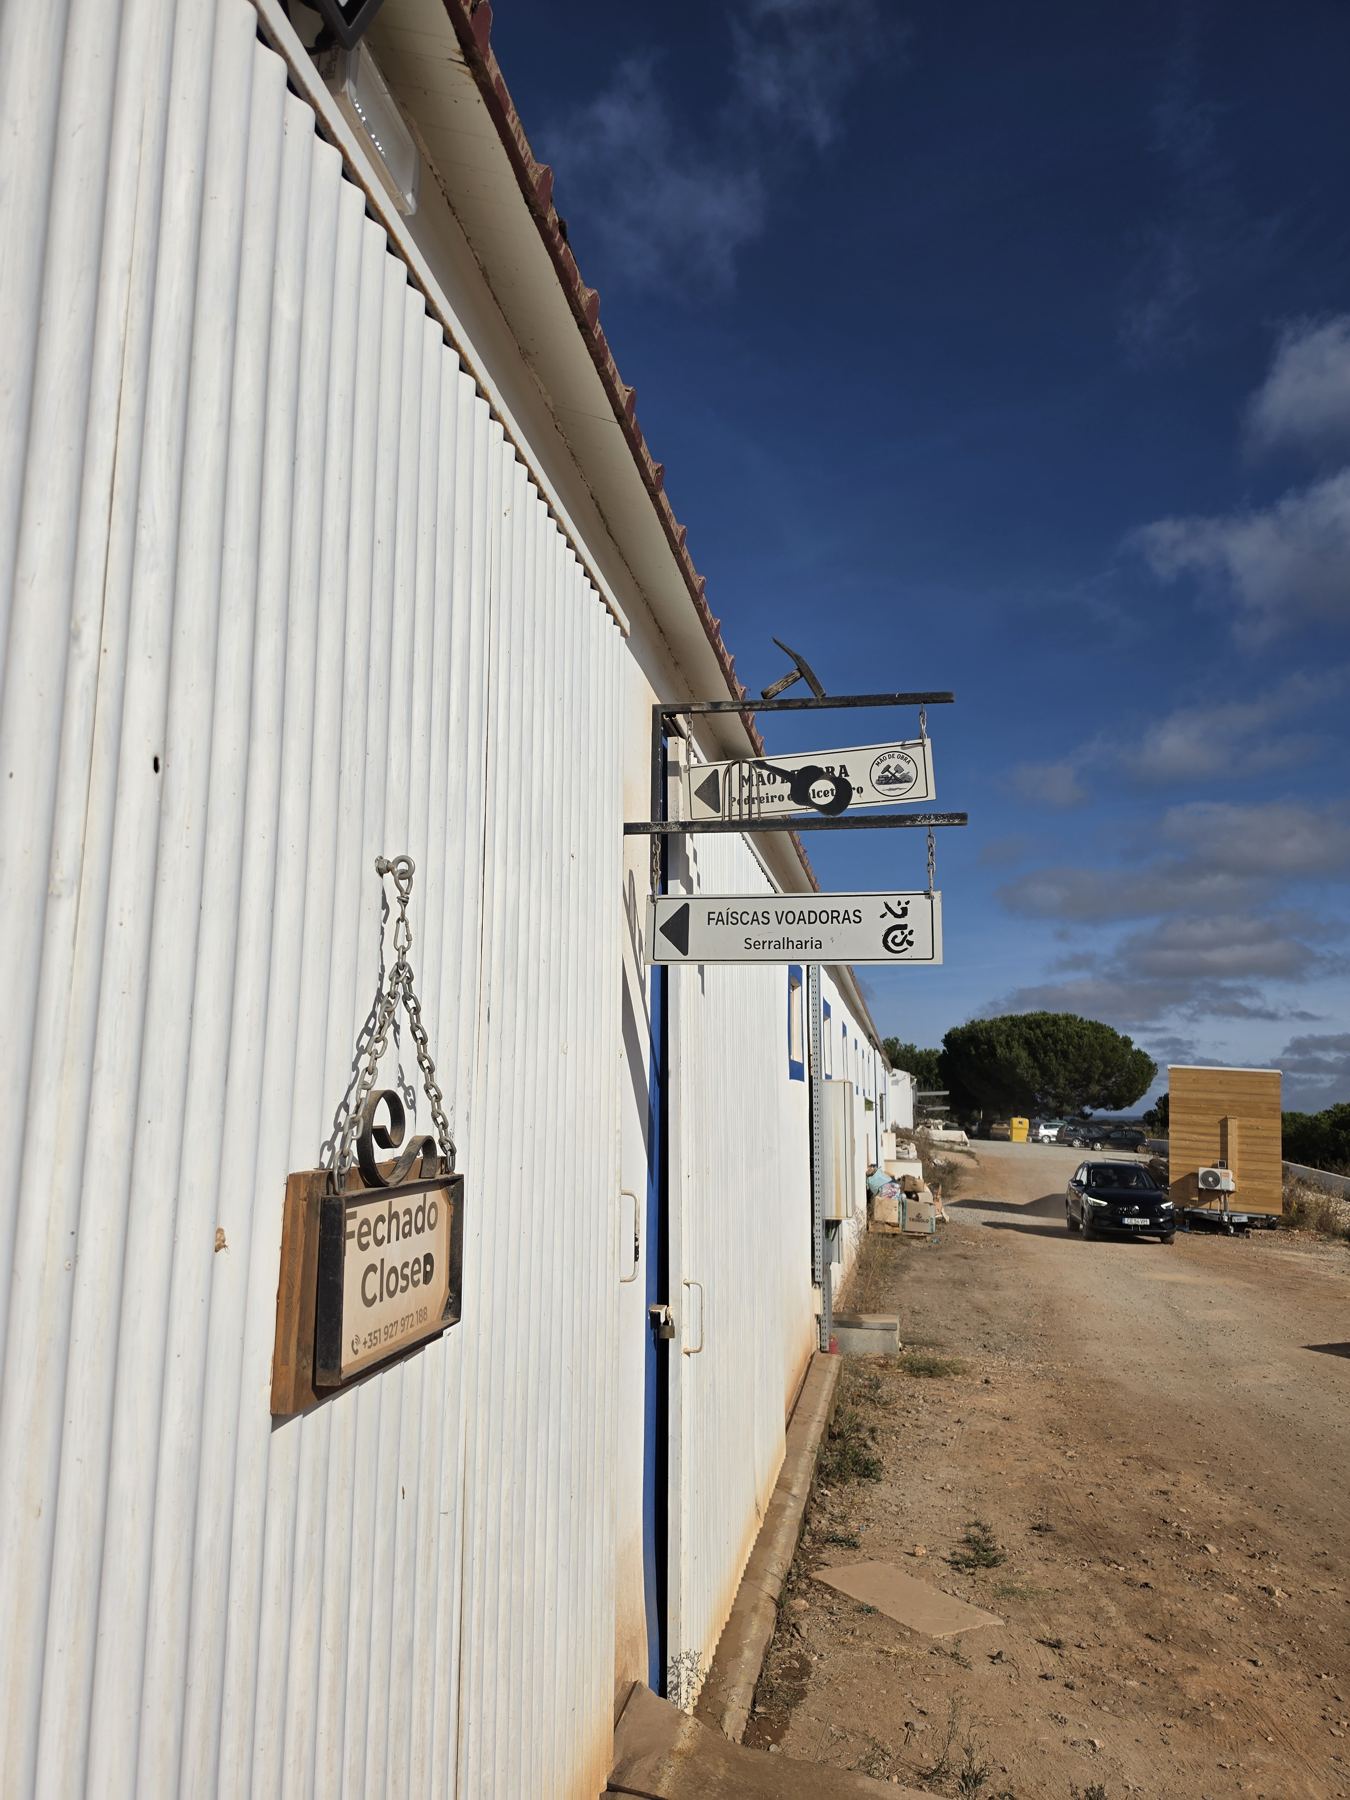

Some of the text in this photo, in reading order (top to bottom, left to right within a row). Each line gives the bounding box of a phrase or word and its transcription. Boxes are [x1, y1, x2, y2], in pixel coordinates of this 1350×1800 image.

[707, 907, 862, 925] FAÍSCAS VOADORAS
[744, 937, 822, 950] Serralharia
[345, 1193, 438, 1252] Fechado
[362, 1328, 381, 1349] +351
[383, 1320, 398, 1342] 927
[400, 1313, 414, 1333] 972
